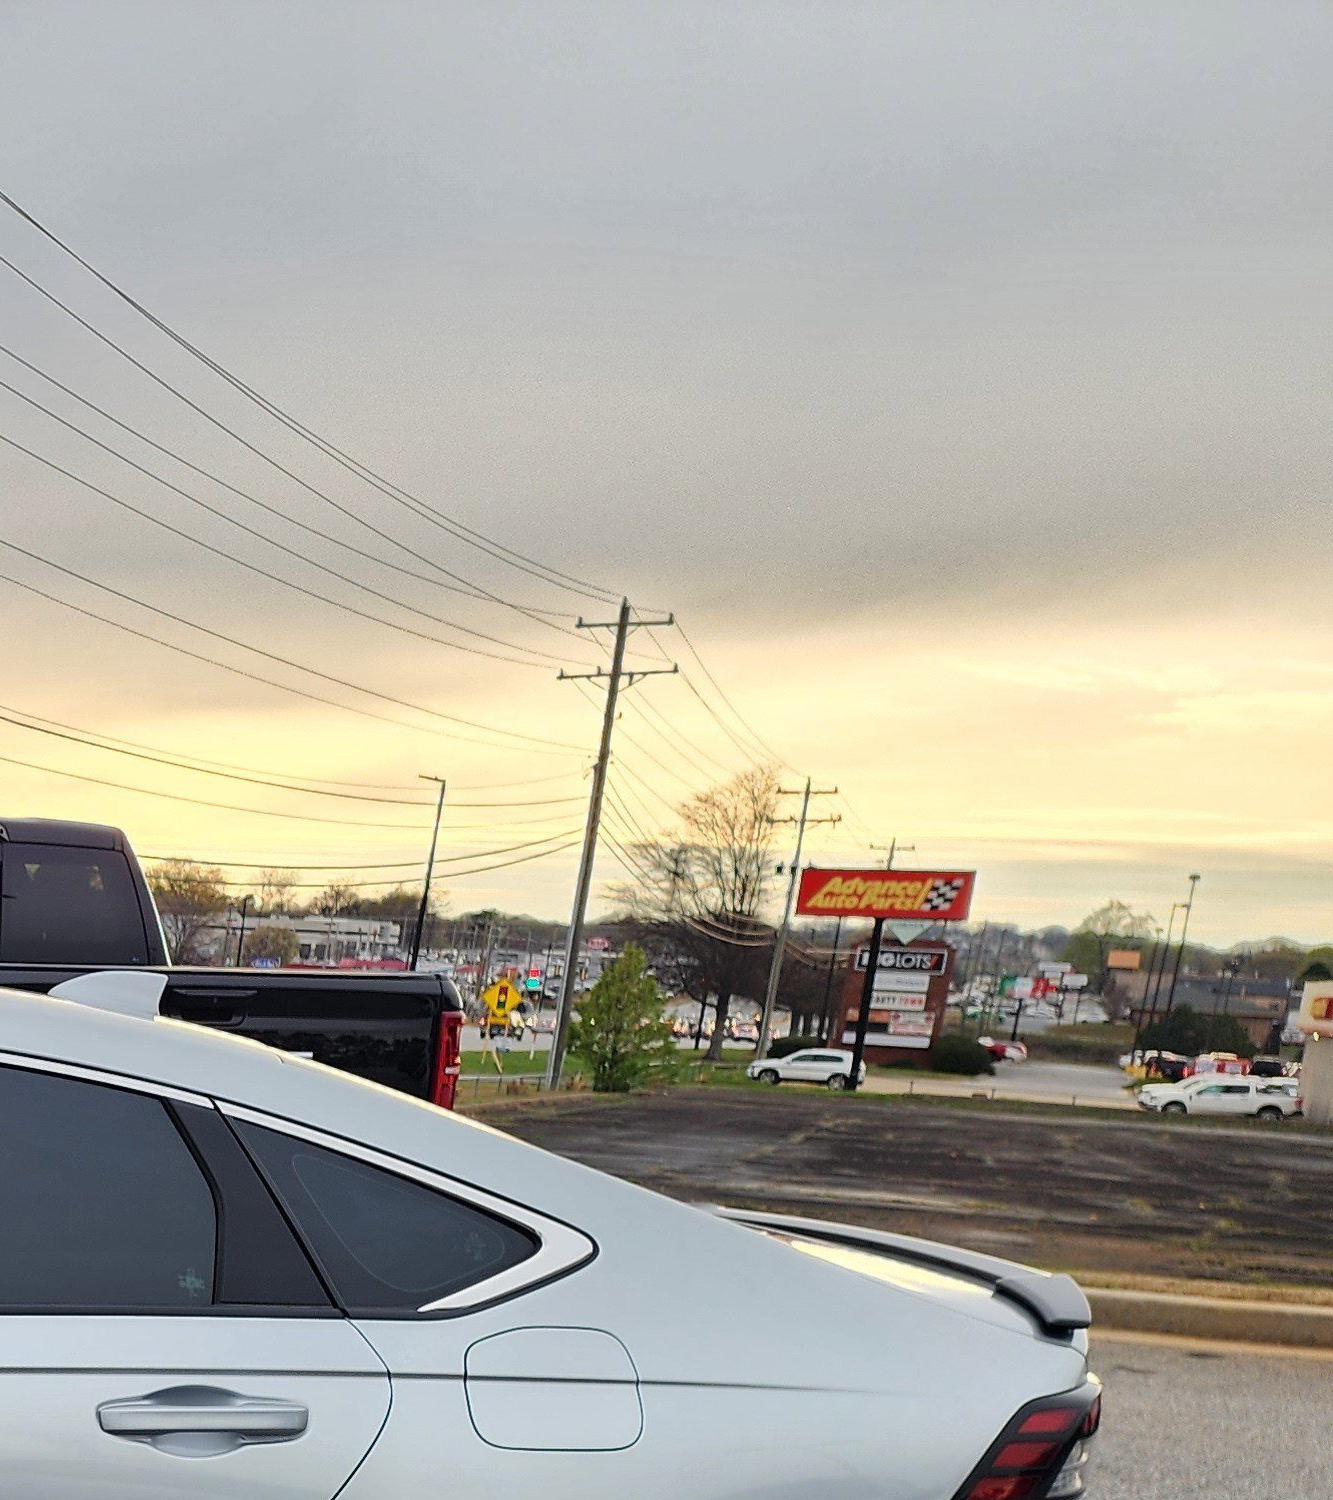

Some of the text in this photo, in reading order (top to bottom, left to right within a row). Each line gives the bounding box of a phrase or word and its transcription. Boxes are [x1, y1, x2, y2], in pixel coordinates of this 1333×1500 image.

[825, 876, 923, 896] Advance
[806, 894, 918, 911] Auto Parts
